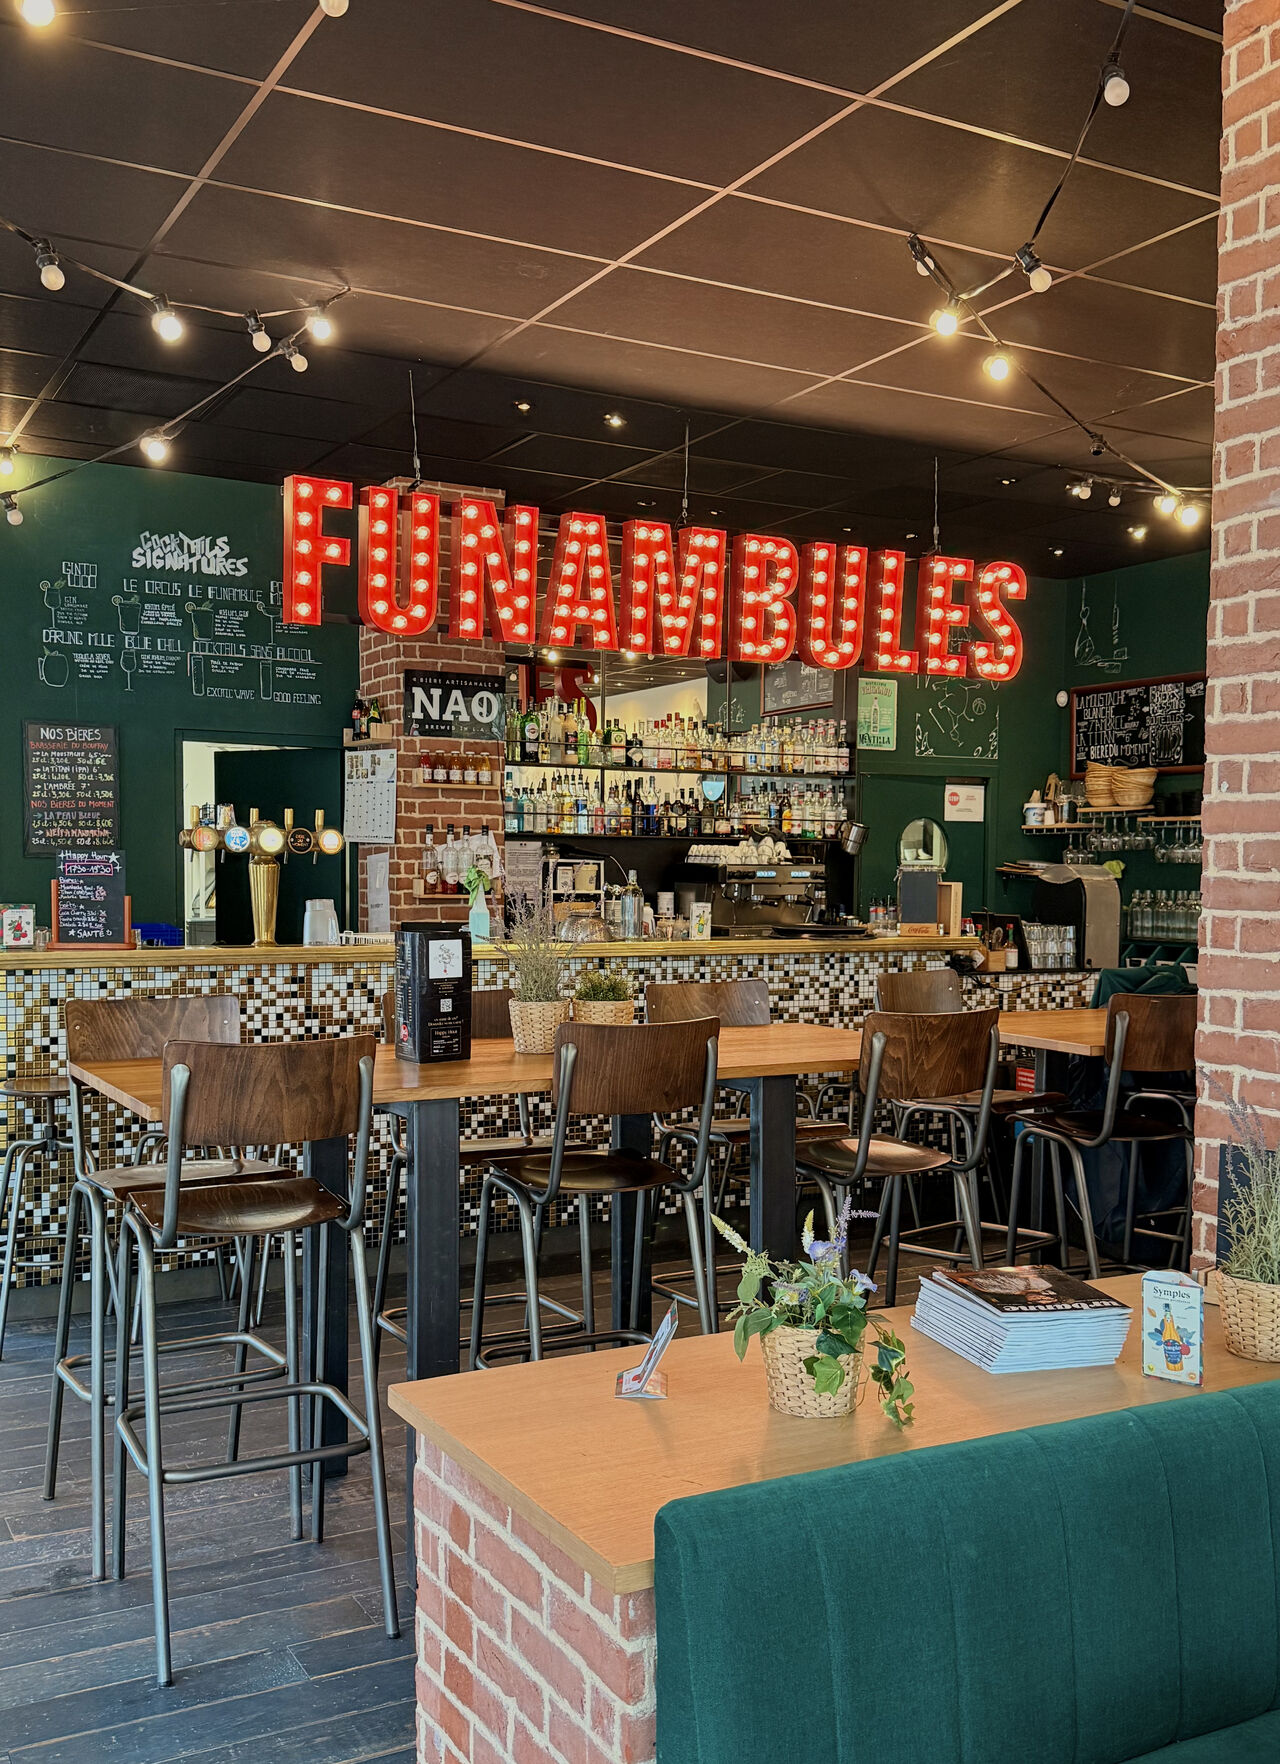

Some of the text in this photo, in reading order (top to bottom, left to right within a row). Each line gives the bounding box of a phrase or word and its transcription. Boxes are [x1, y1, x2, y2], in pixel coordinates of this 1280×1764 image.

[284, 474, 1028, 682] FUNAMBULES
[124, 578, 181, 596] LE CIRCUS
[189, 584, 202, 598] LE
[208, 586, 263, 603] FUNAMBULE
[43, 629, 83, 645] DARLING
[193, 641, 246, 657] COCKTAILS
[277, 647, 315, 662] ALCOOL
[445, 679, 492, 688] ARTISANALE
[411, 686, 499, 724] NAO
[1085, 690, 1126, 708] MOUSTACHE
[1083, 705, 1116, 720] BLANCHE
[40, 728, 64, 740] NOS
[1090, 745, 1109, 760] BIERE
[1120, 742, 1149, 757] MOMENT
[88, 800, 114, 808] MOMENT
[65, 850, 108, 863] Happy Hour
[77, 928, 105, 938] SANTÉ
[1153, 1286, 1191, 1300] Symples
